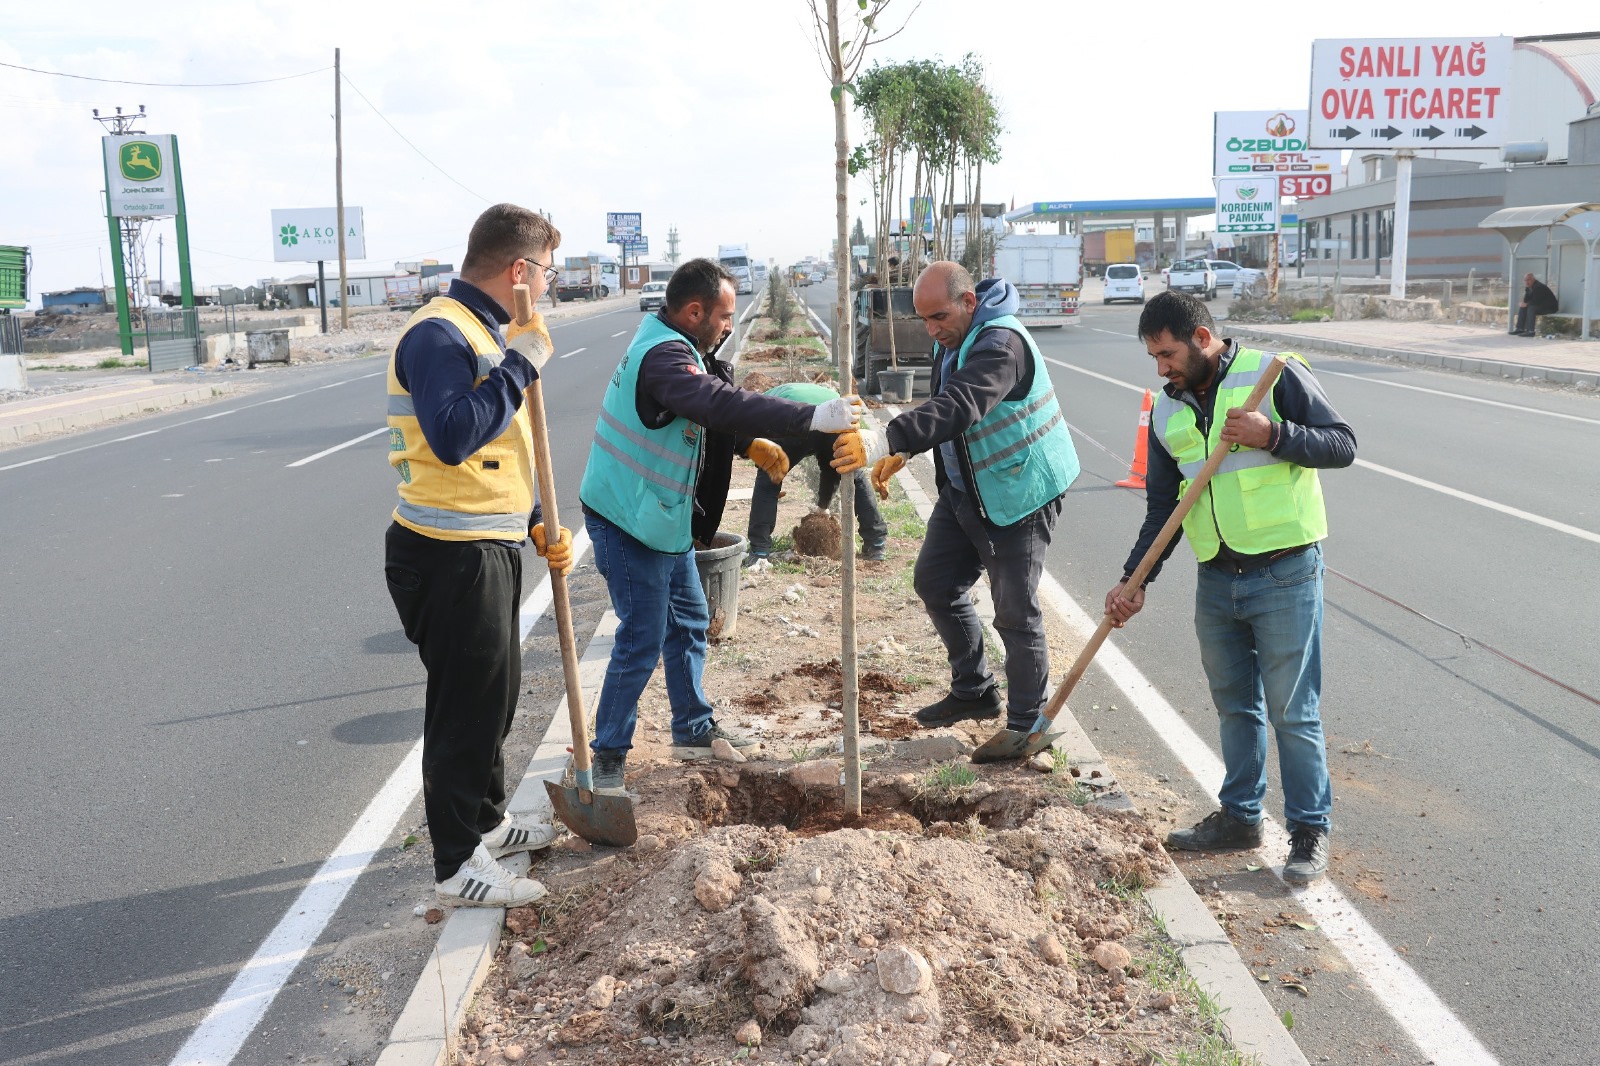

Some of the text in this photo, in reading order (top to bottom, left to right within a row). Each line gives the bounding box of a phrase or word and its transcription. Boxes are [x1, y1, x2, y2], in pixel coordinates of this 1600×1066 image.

[1339, 41, 1486, 81] ŞANLI YAĞ
[1321, 88, 1375, 120] OVA
[1282, 178, 1327, 194] STO
[1229, 213, 1264, 223] PAMUK
[303, 227, 356, 238] AKOA
